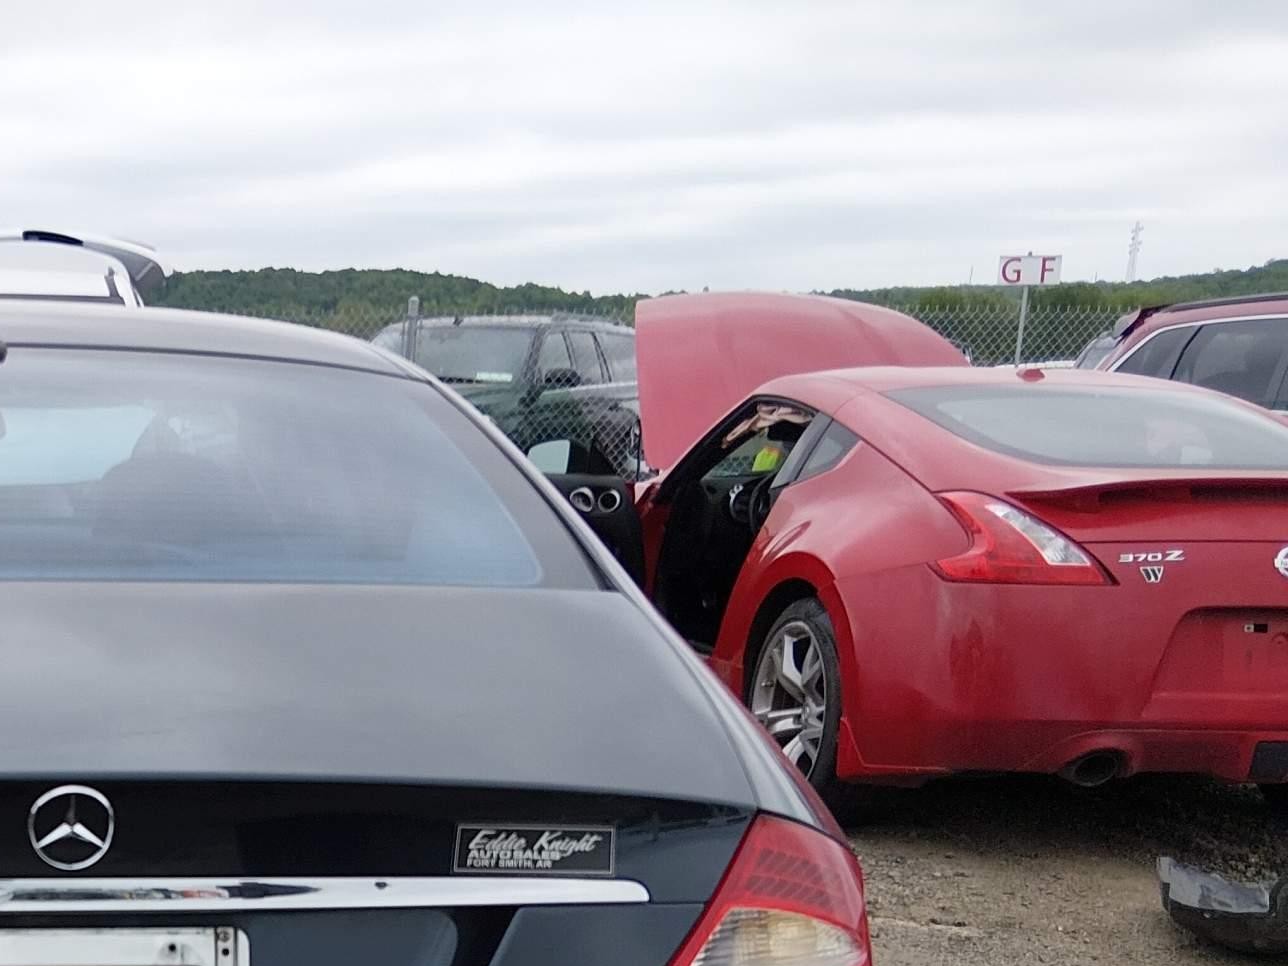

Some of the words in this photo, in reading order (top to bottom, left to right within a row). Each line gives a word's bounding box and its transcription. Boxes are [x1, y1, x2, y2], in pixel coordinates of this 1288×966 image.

[1001, 257, 1022, 284] G
[1040, 256, 1056, 284] F
[468, 829, 526, 850] Eddie
[533, 830, 603, 857] Knight
[466, 858, 496, 868] FORT
[535, 859, 553, 869] AR
[467, 849, 512, 860] AUTO
[512, 849, 561, 861] SALES
